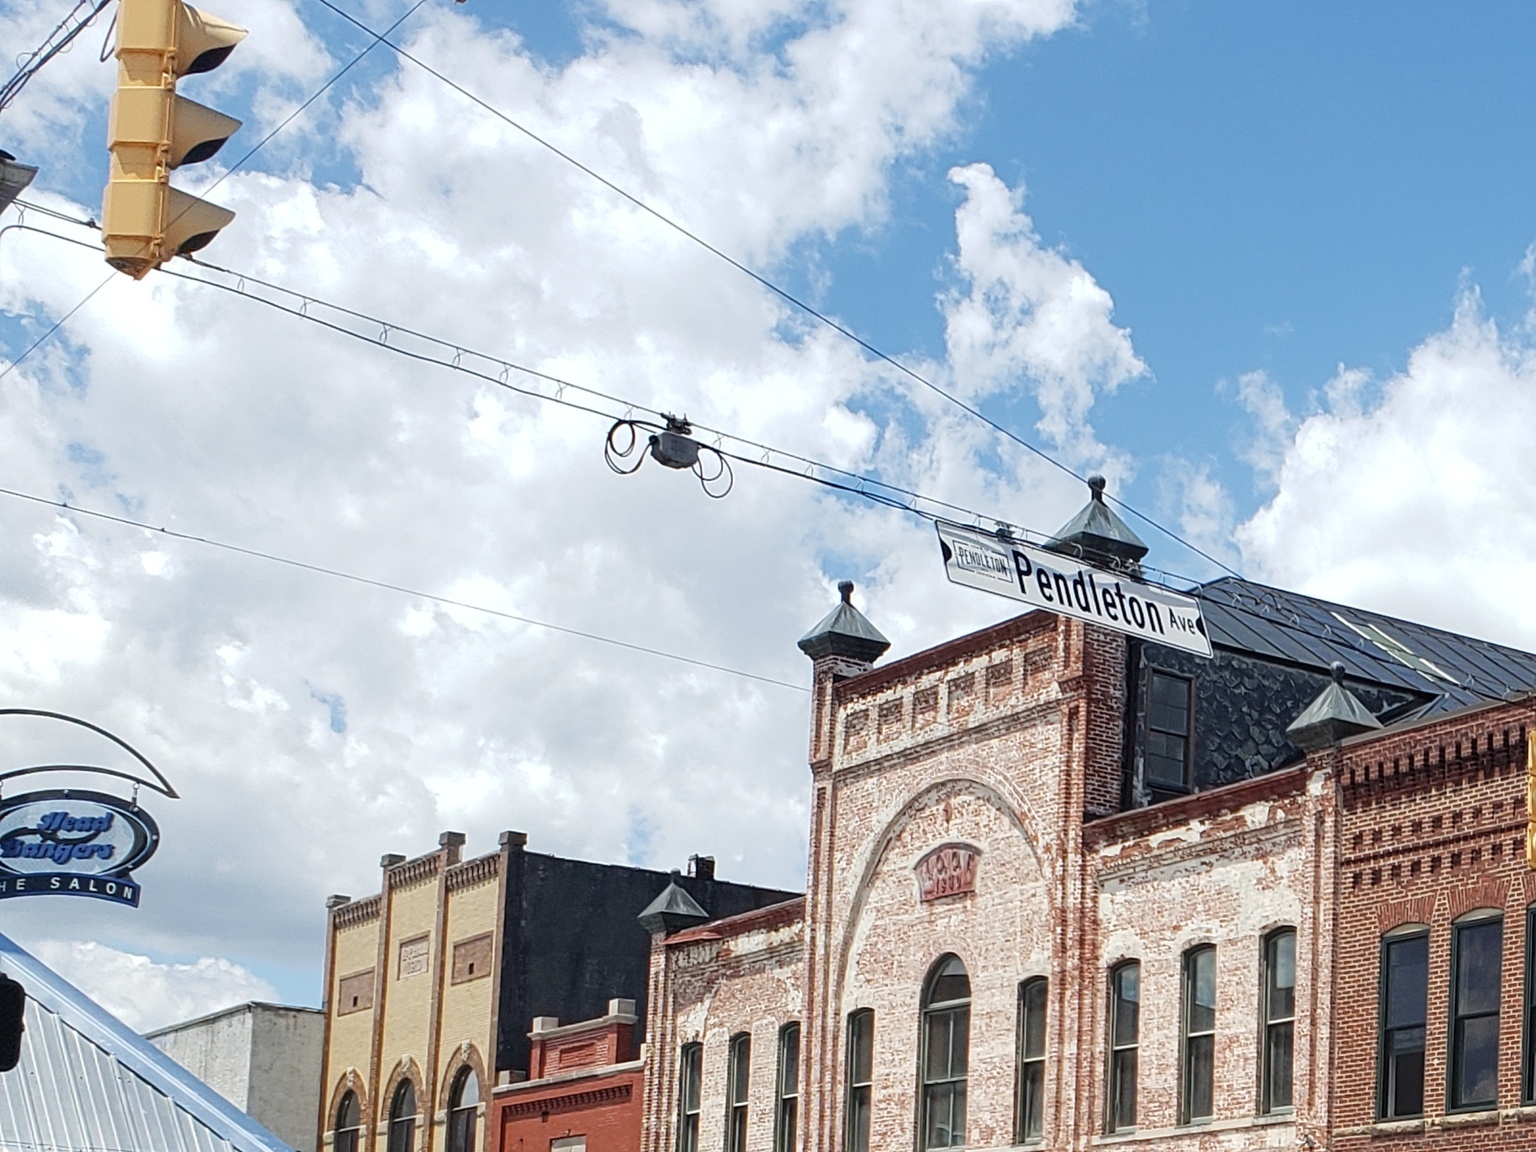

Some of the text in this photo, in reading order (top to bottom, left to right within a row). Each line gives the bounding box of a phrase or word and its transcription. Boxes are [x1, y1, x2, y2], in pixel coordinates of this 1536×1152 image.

[958, 546, 1008, 578] PENDLETON
[1011, 549, 1195, 635] Pendleton Ave
[37, 811, 115, 832] Head
[0, 838, 116, 865] Bangers
[50, 877, 133, 899] SALON
